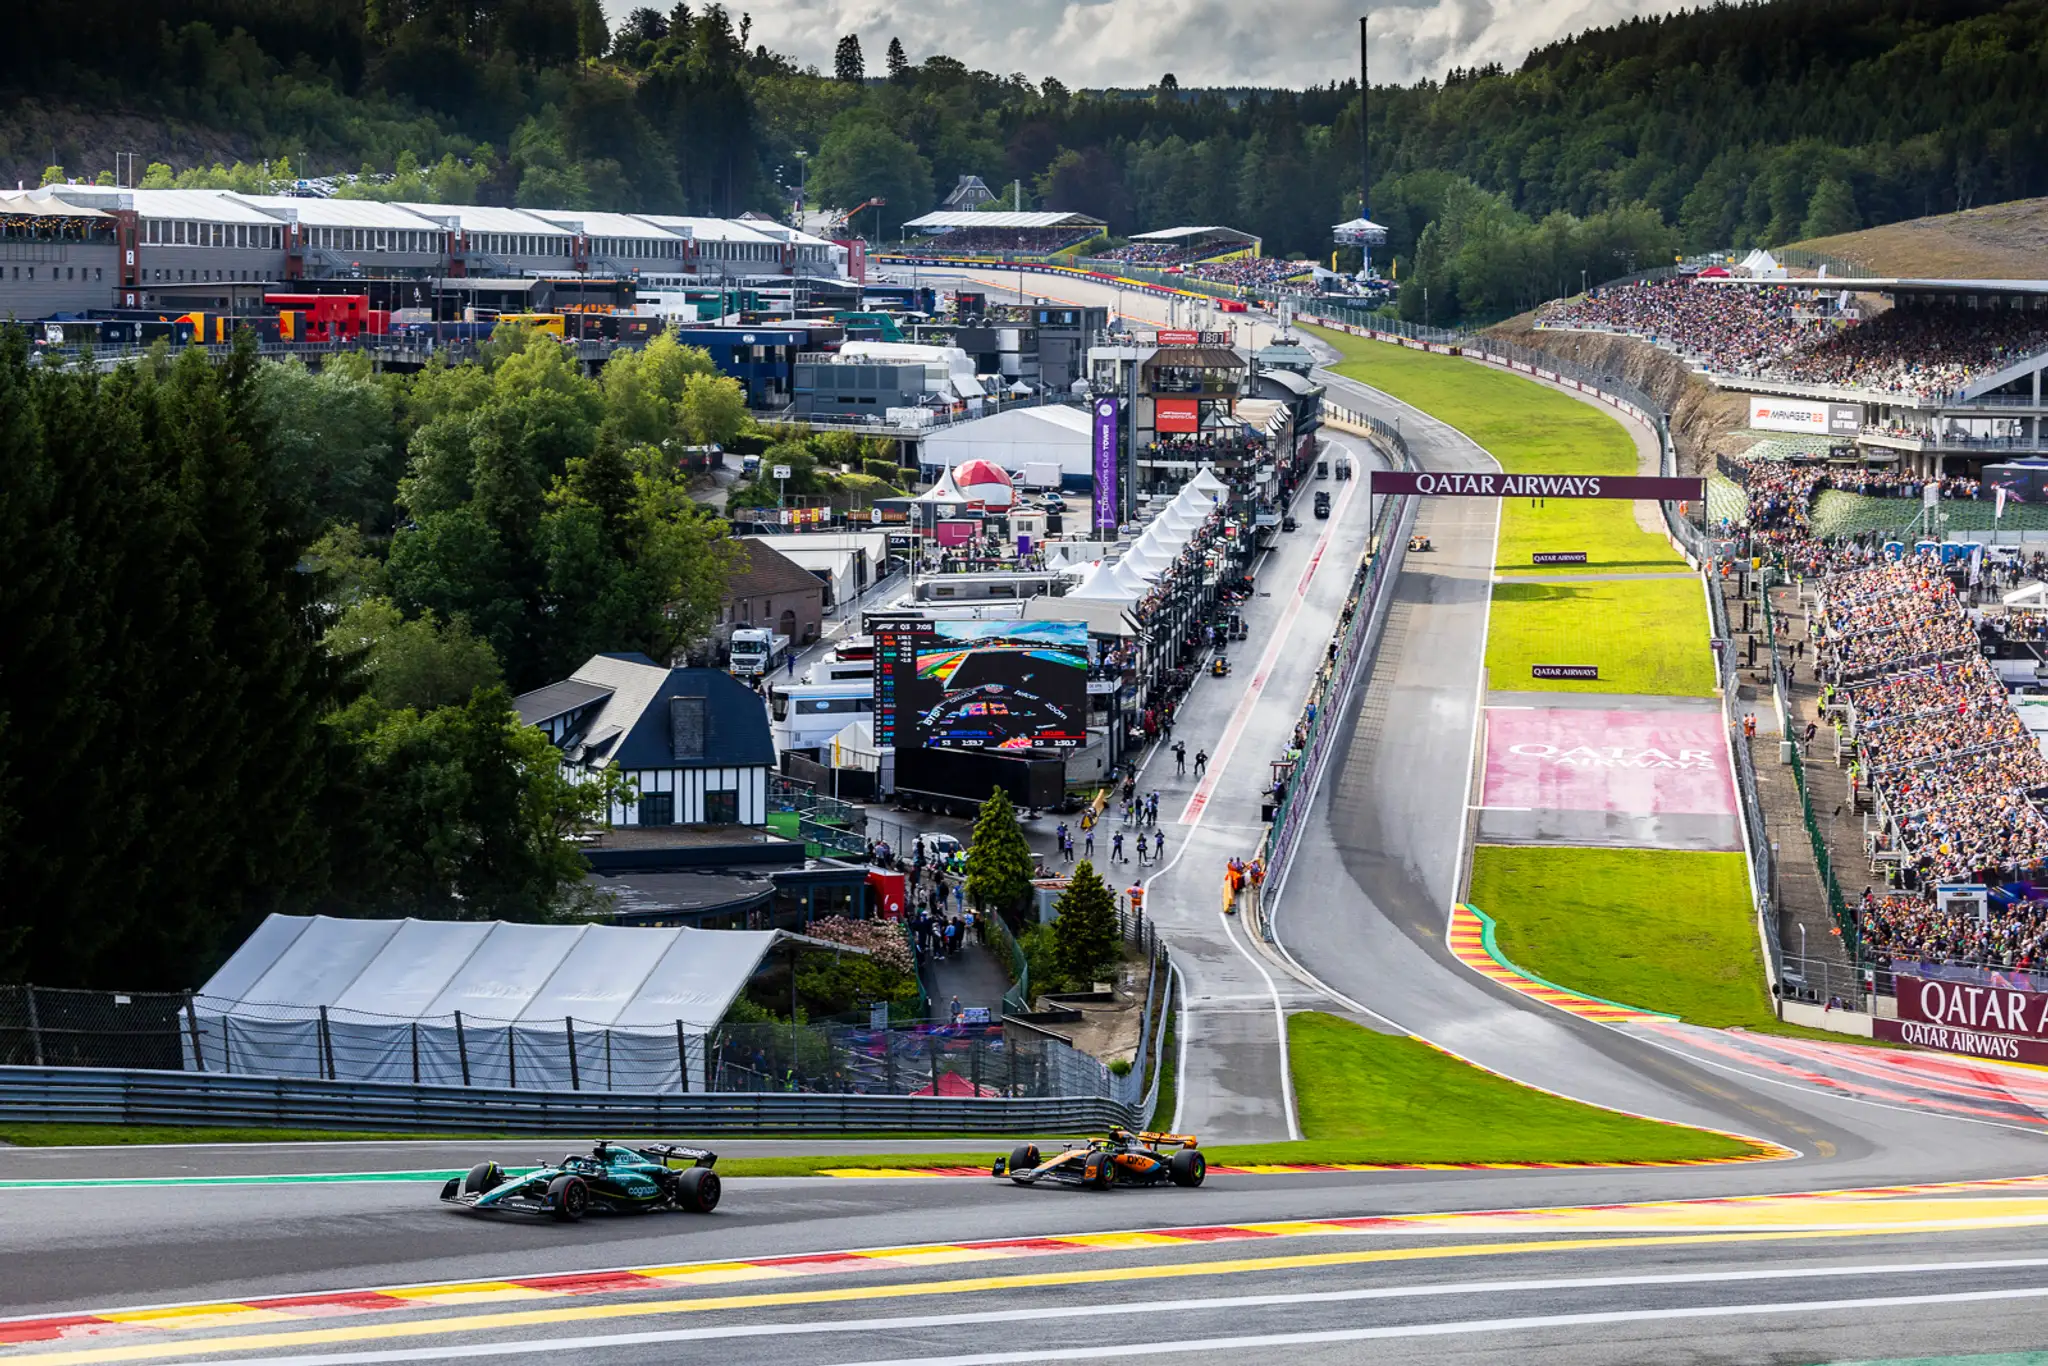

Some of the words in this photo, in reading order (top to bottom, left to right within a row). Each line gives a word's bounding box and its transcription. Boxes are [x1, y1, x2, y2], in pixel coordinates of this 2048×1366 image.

[1202, 332, 1224, 343] 18:07
[1771, 410, 1812, 421] MANAGER
[1101, 469, 1110, 511] Champions
[1415, 473, 1494, 495] QATAR
[1500, 476, 1601, 496] AIRWAYS
[1533, 554, 1557, 562] QATAR
[1558, 553, 1586, 562] AIRWAYS
[1533, 667, 1561, 676] QATAR
[1562, 667, 1597, 676] AIRWAYS
[1044, 702, 1067, 720] zoom
[1509, 743, 1713, 762] QATAR
[1553, 757, 1717, 770] AIRWAYS
[1921, 981, 2029, 1032] QATAR
[1901, 1022, 1949, 1048] QATAR
[1951, 1031, 2019, 1058] AIRWAYS
